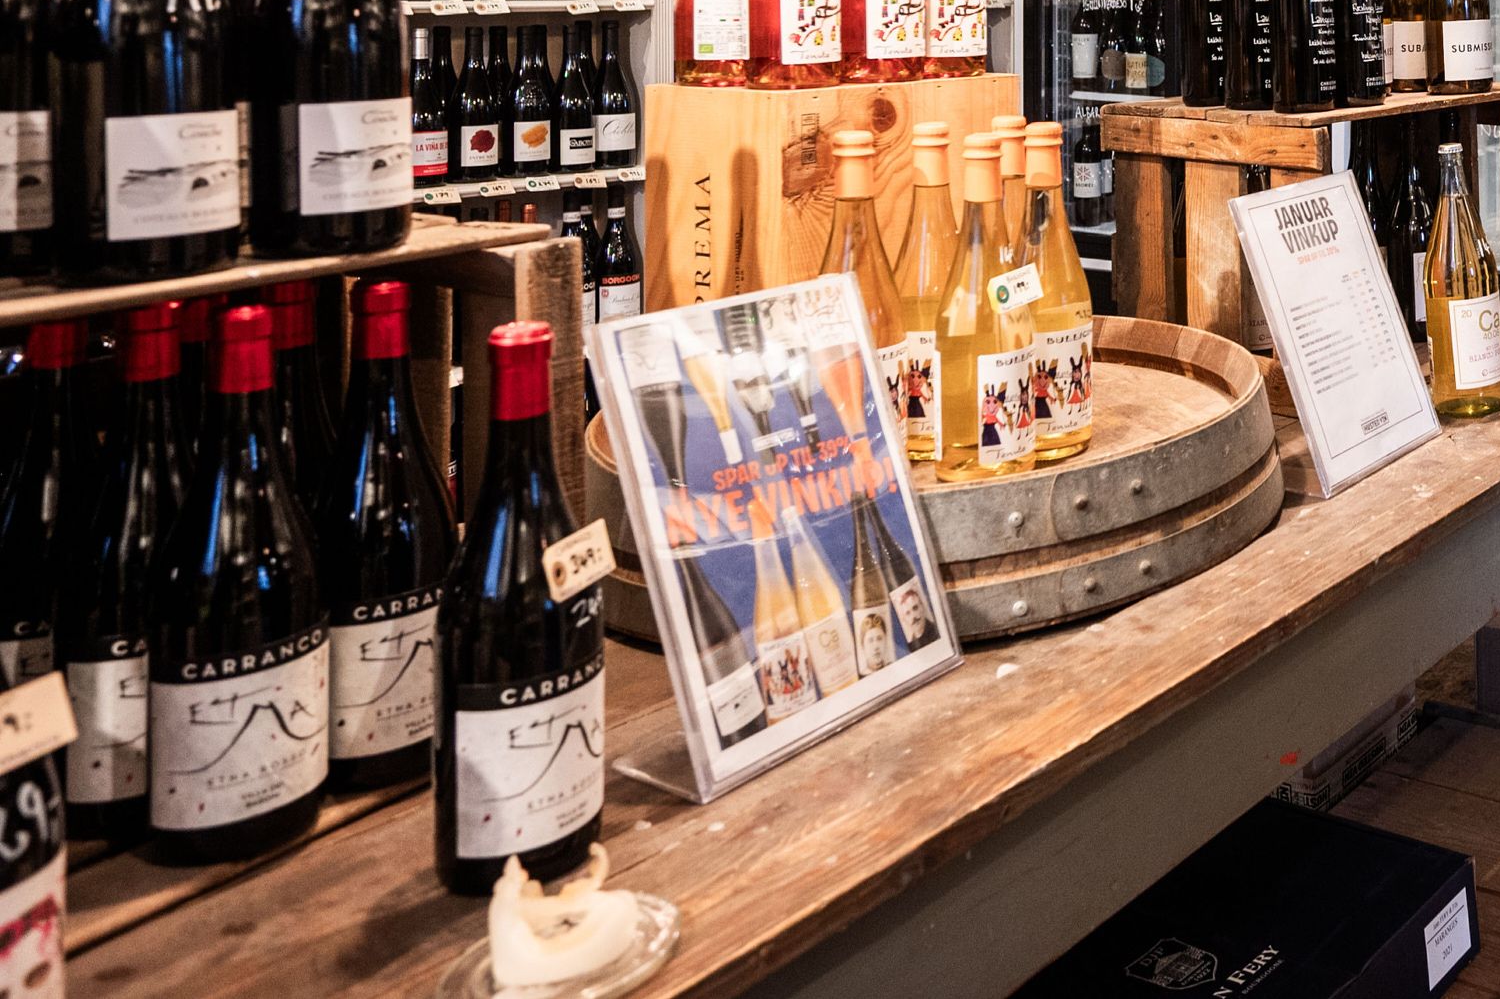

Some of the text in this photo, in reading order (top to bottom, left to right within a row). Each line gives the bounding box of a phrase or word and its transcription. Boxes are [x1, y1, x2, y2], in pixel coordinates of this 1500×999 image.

[1274, 196, 1334, 231] JANUAR
[1280, 219, 1340, 255] VINKUP
[1478, 309, 1500, 332] Ca
[712, 462, 761, 491] SPAR
[181, 628, 324, 680] CARRANCO
[1434, 918, 1459, 947] MARANGES
